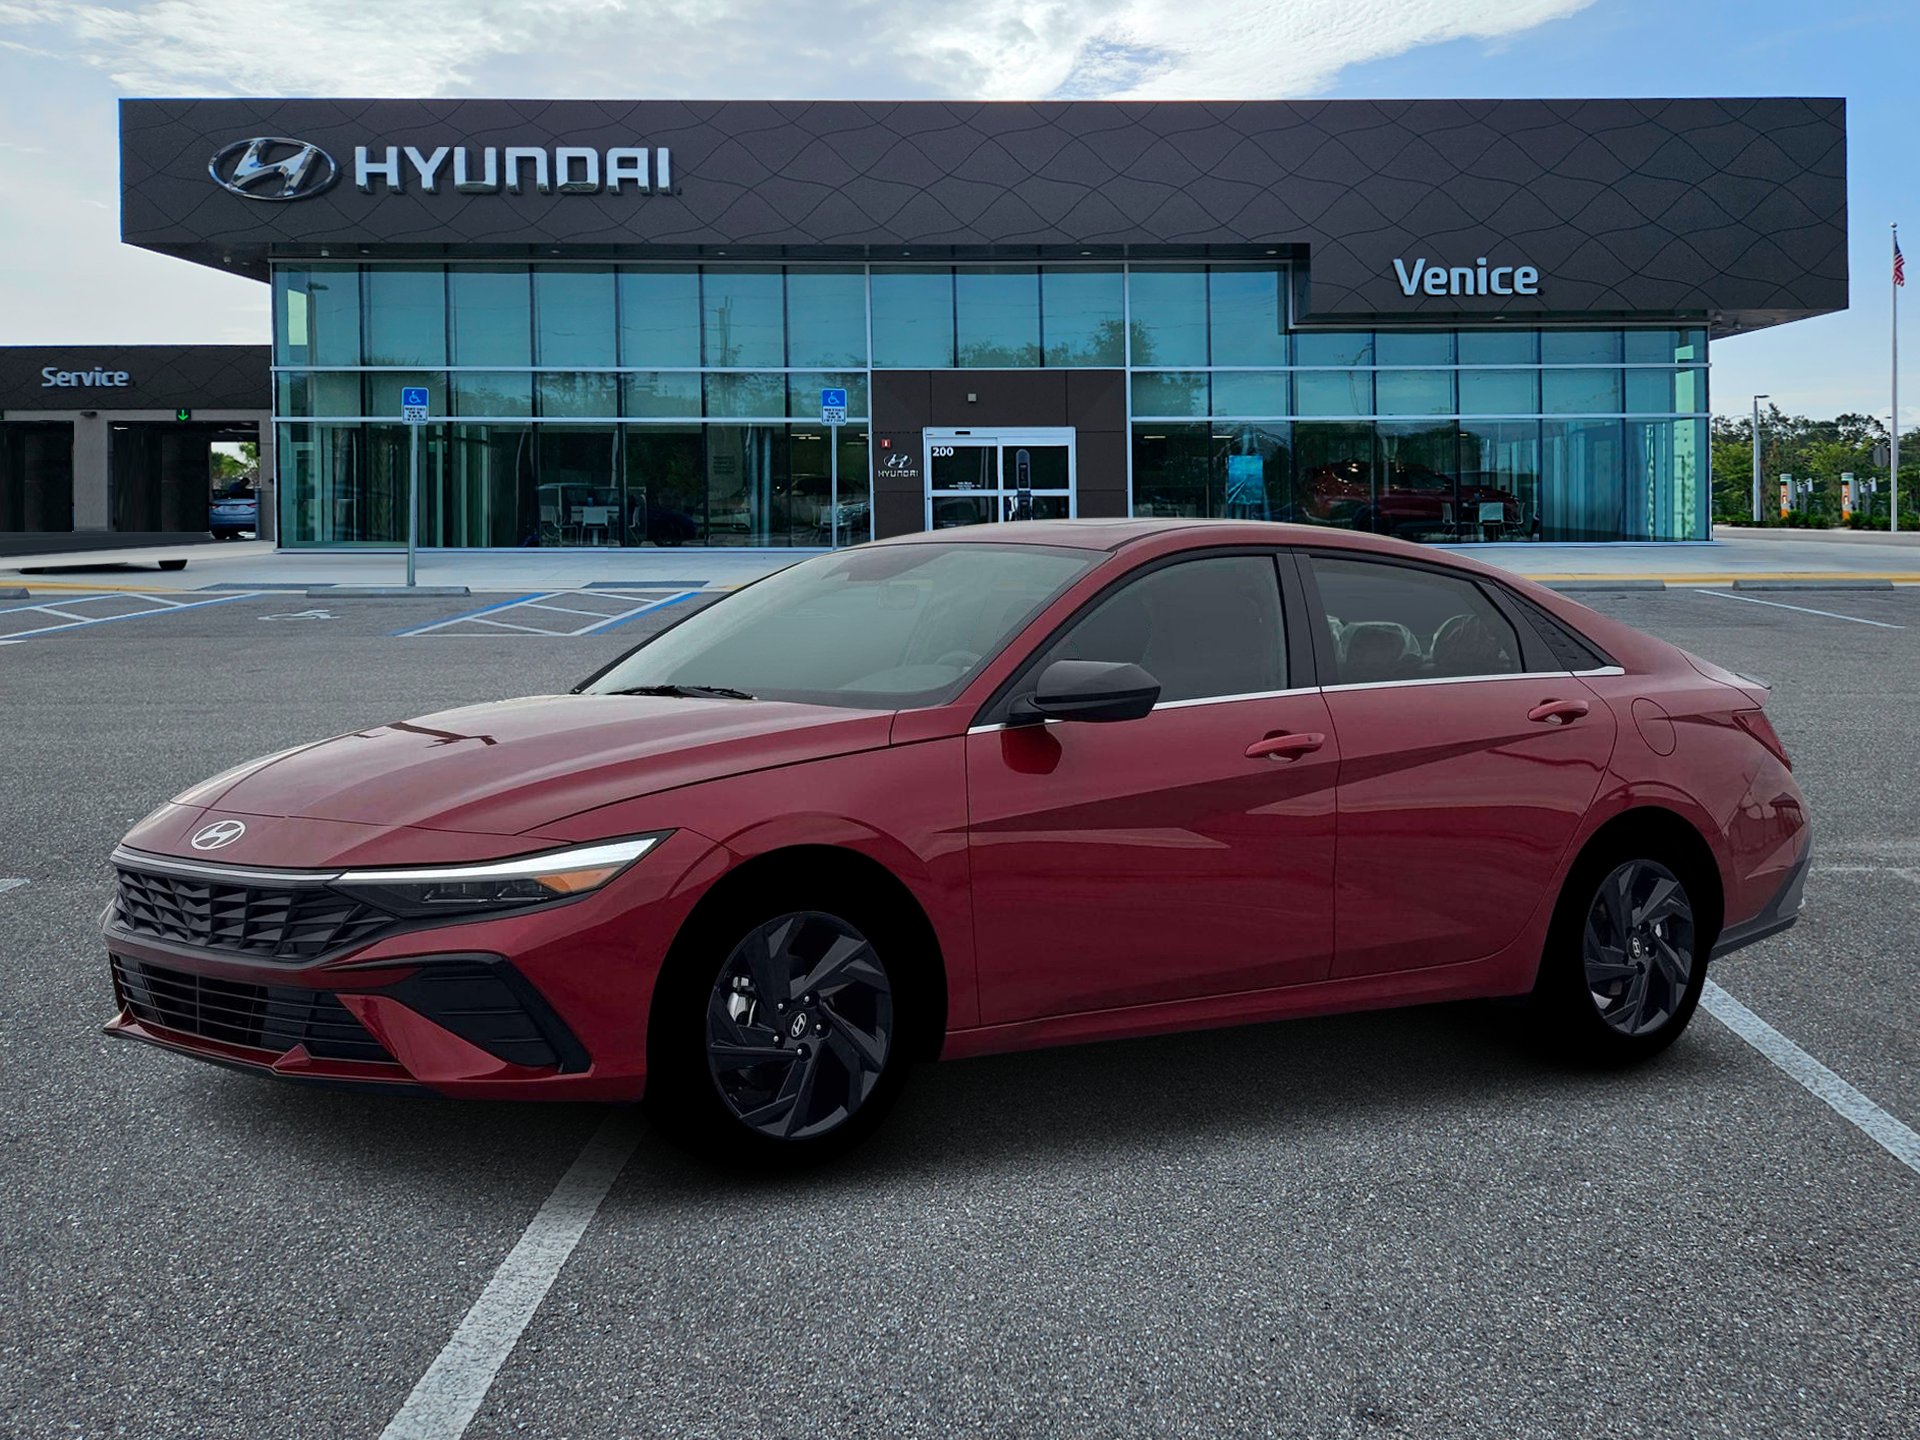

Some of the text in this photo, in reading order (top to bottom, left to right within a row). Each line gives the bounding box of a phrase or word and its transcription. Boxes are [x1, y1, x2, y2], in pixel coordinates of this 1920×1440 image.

[354, 146, 670, 194] HYUNDAI
[1393, 257, 1539, 296] Venice
[41, 366, 130, 388] Service
[932, 447, 954, 457] 200
[878, 470, 919, 478] HYUNDAI
